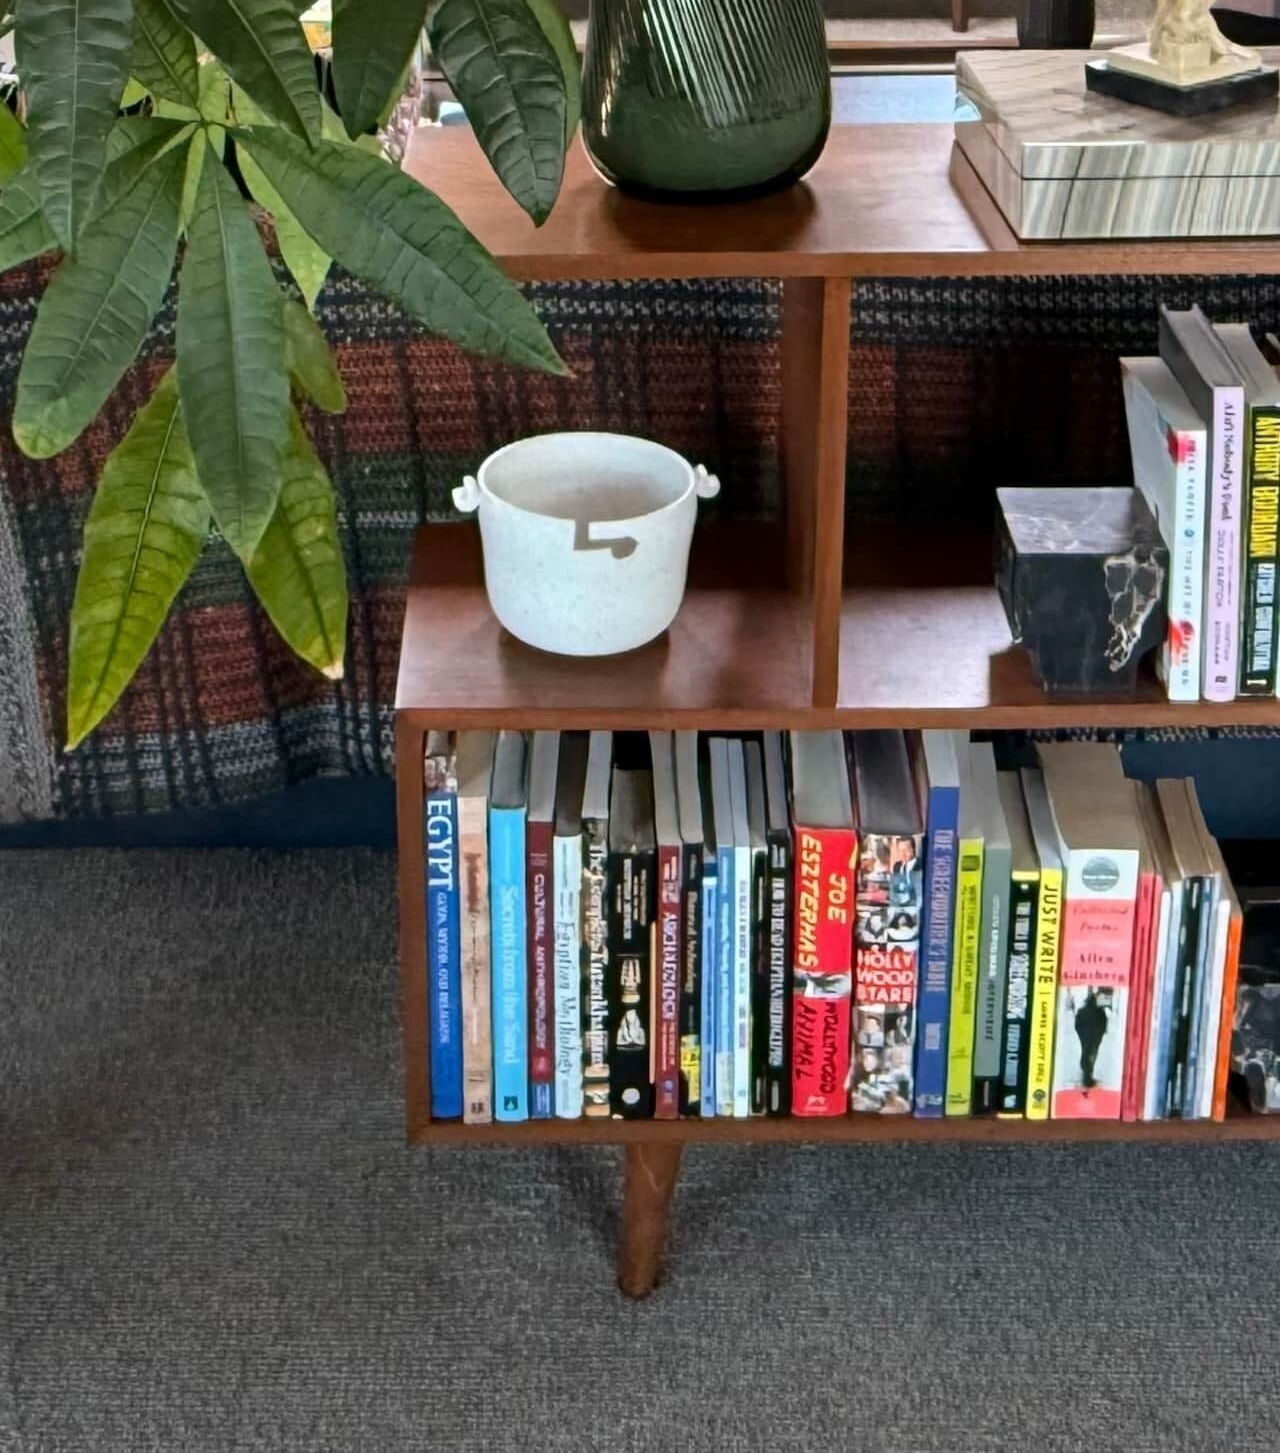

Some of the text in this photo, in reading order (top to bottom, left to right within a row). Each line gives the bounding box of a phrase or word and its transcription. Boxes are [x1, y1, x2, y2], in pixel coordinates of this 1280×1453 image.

[1220, 434, 1235, 491] Nobody's
[1249, 485, 1280, 557] BOURDAIN
[426, 797, 454, 892] EGYPT
[932, 828, 954, 850] THE
[799, 832, 824, 968] ESZTERHAS
[827, 872, 847, 924] JOE
[928, 853, 952, 957] SCREENWRITER'S
[1038, 883, 1061, 984] JUST WRITE
[500, 884, 522, 1065] Secrets from the Sand
[533, 872, 548, 1052] CULTURAL ANTHROPOLOGY
[556, 921, 578, 990] Egyptian
[856, 968, 914, 986] WOOD
[857, 949, 913, 969] HOLLY
[1079, 953, 1113, 964] Allen
[558, 995, 577, 1075] Mythology
[795, 1000, 818, 1083] ANIMAL
[819, 1000, 840, 1095] HOLLYWOOD
